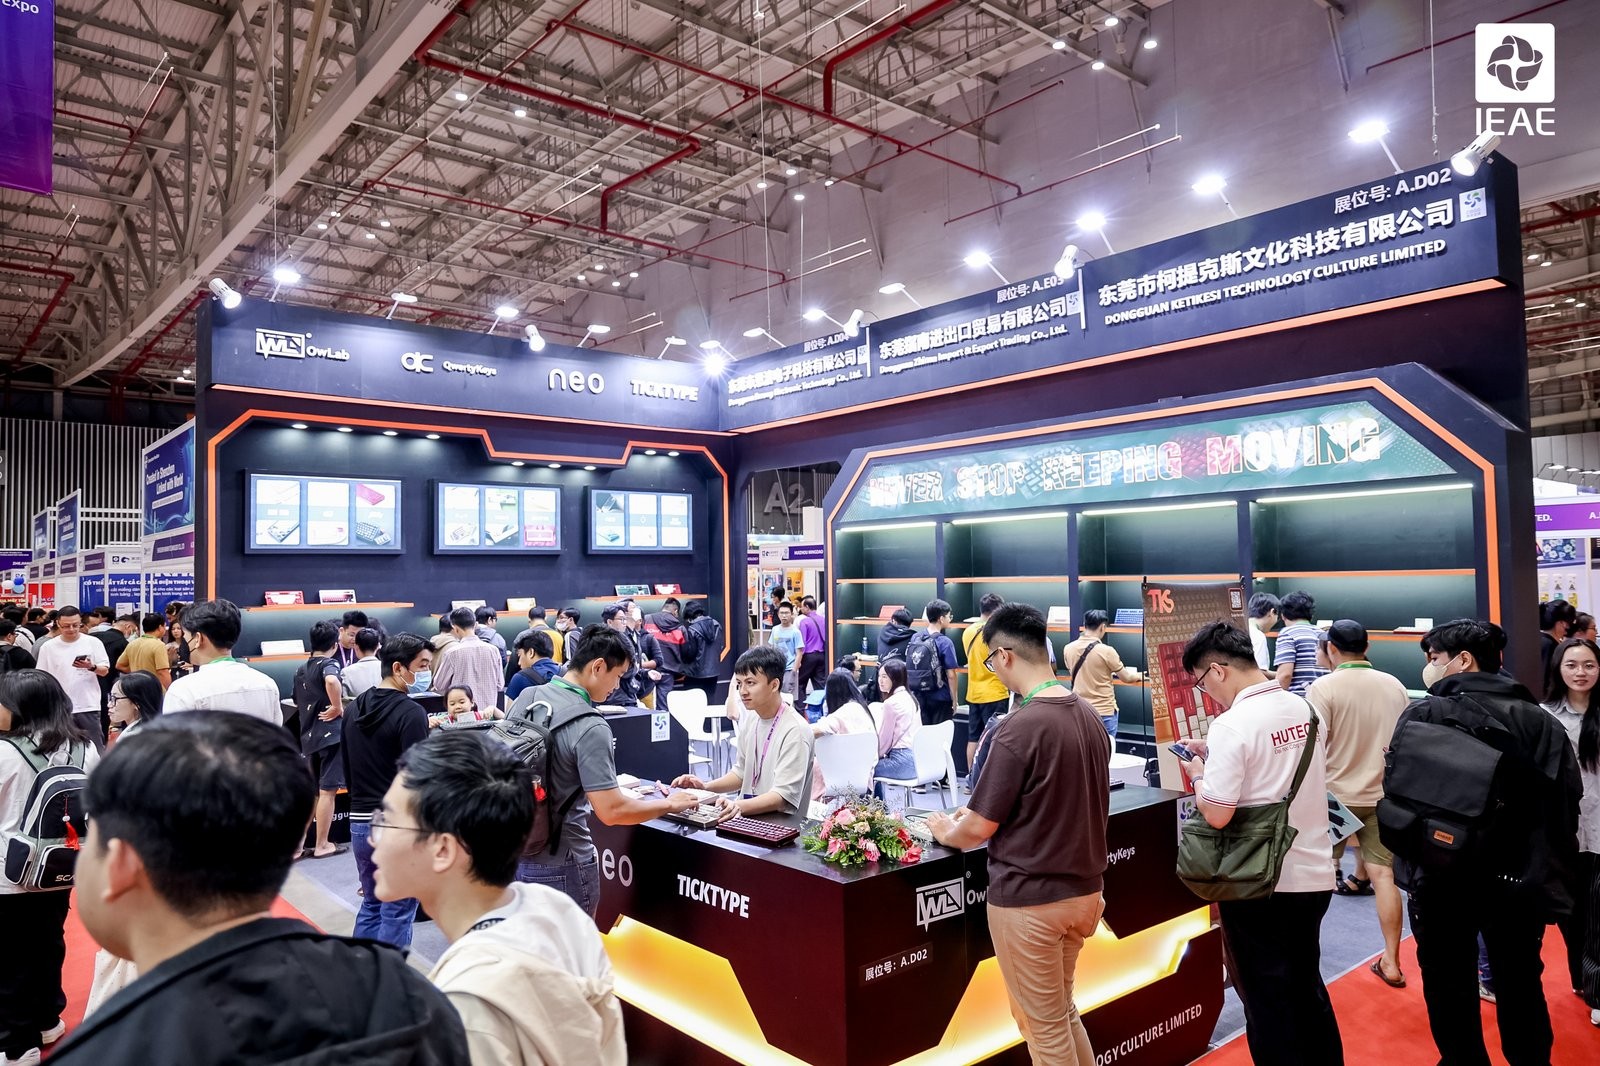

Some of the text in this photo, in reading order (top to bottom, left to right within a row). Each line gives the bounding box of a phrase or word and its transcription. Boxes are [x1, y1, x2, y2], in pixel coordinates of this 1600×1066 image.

[1334, 167, 1452, 214] 展位号: A.D02
[1098, 198, 1454, 307] 东莞市柯提克斯文化科技有限公司
[1104, 239, 1446, 325] DONGGUAN KETIKESI TECHNOLOGY CULTURE LIMITED
[306, 345, 350, 361] OwLab
[972, 340, 999, 354] Export
[999, 333, 1031, 347] Trading
[442, 360, 497, 376] QwertyKeys
[549, 368, 605, 394] neo
[630, 379, 699, 401] TICKTYPE
[1042, 442, 1182, 491] KEEPING
[1205, 417, 1381, 476] MOVING
[764, 482, 806, 514] A2
[1271, 722, 1318, 746] HUTEC
[1106, 846, 1136, 865] rtyKeys
[677, 874, 750, 919] TICKTYPE
[966, 886, 989, 905] Ow
[900, 948, 928, 968] A.D02
[1096, 1003, 1203, 1066] OGY CULTURE LIMITED
